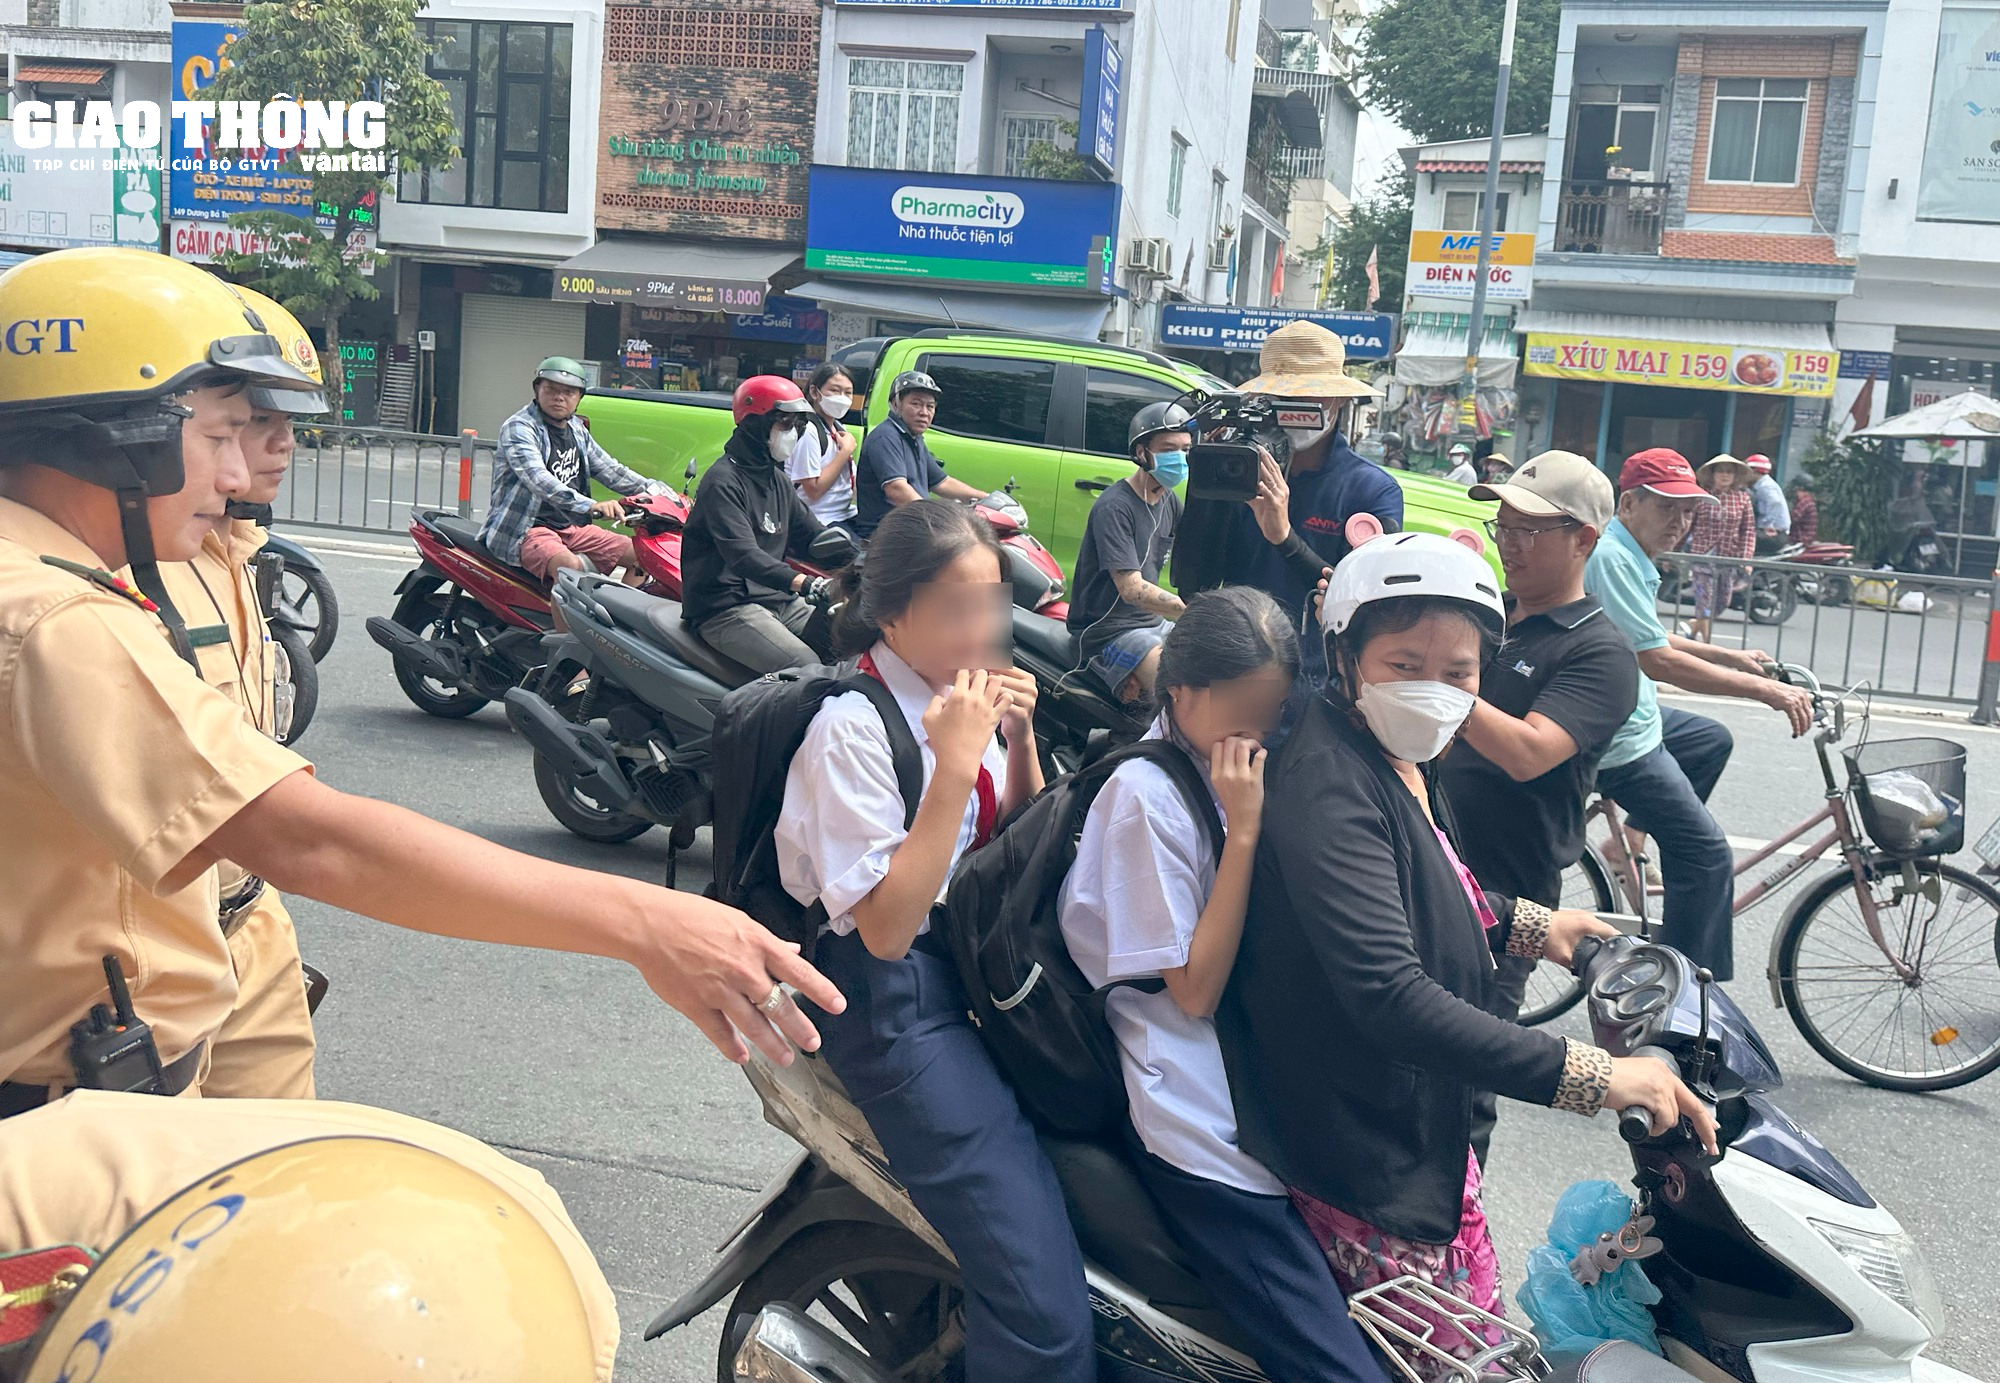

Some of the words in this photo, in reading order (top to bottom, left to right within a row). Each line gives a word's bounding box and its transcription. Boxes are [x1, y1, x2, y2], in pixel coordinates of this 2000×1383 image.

[608, 131, 638, 157] Sầu
[641, 138, 685, 162] riêng
[753, 143, 800, 166] nhiên
[637, 164, 690, 188] durian
[174, 208, 186, 216] 149
[901, 196, 1014, 224] Pharmacity
[176, 221, 210, 256] CẦM
[899, 224, 926, 239] Nhà
[929, 226, 966, 242] thuốc
[970, 229, 995, 246] tiện
[998, 230, 1014, 247] lợi
[1426, 264, 1463, 284] ĐIỆN
[1468, 266, 1512, 283] NỚC
[561, 276, 595, 294] 9.000
[718, 288, 761, 306] 18.000
[1241, 318, 1266, 327] KHU
[0, 319, 85, 355] GT
[1167, 325, 1214, 338] KHU
[1220, 327, 1268, 341] PHỐ
[1558, 340, 1608, 370] XÍU
[1614, 348, 1668, 380] MẠI
[1680, 354, 1728, 378] 159
[1794, 354, 1829, 374] 159
[1279, 413, 1320, 423] ANTV
[1303, 516, 1342, 530] ANTV
